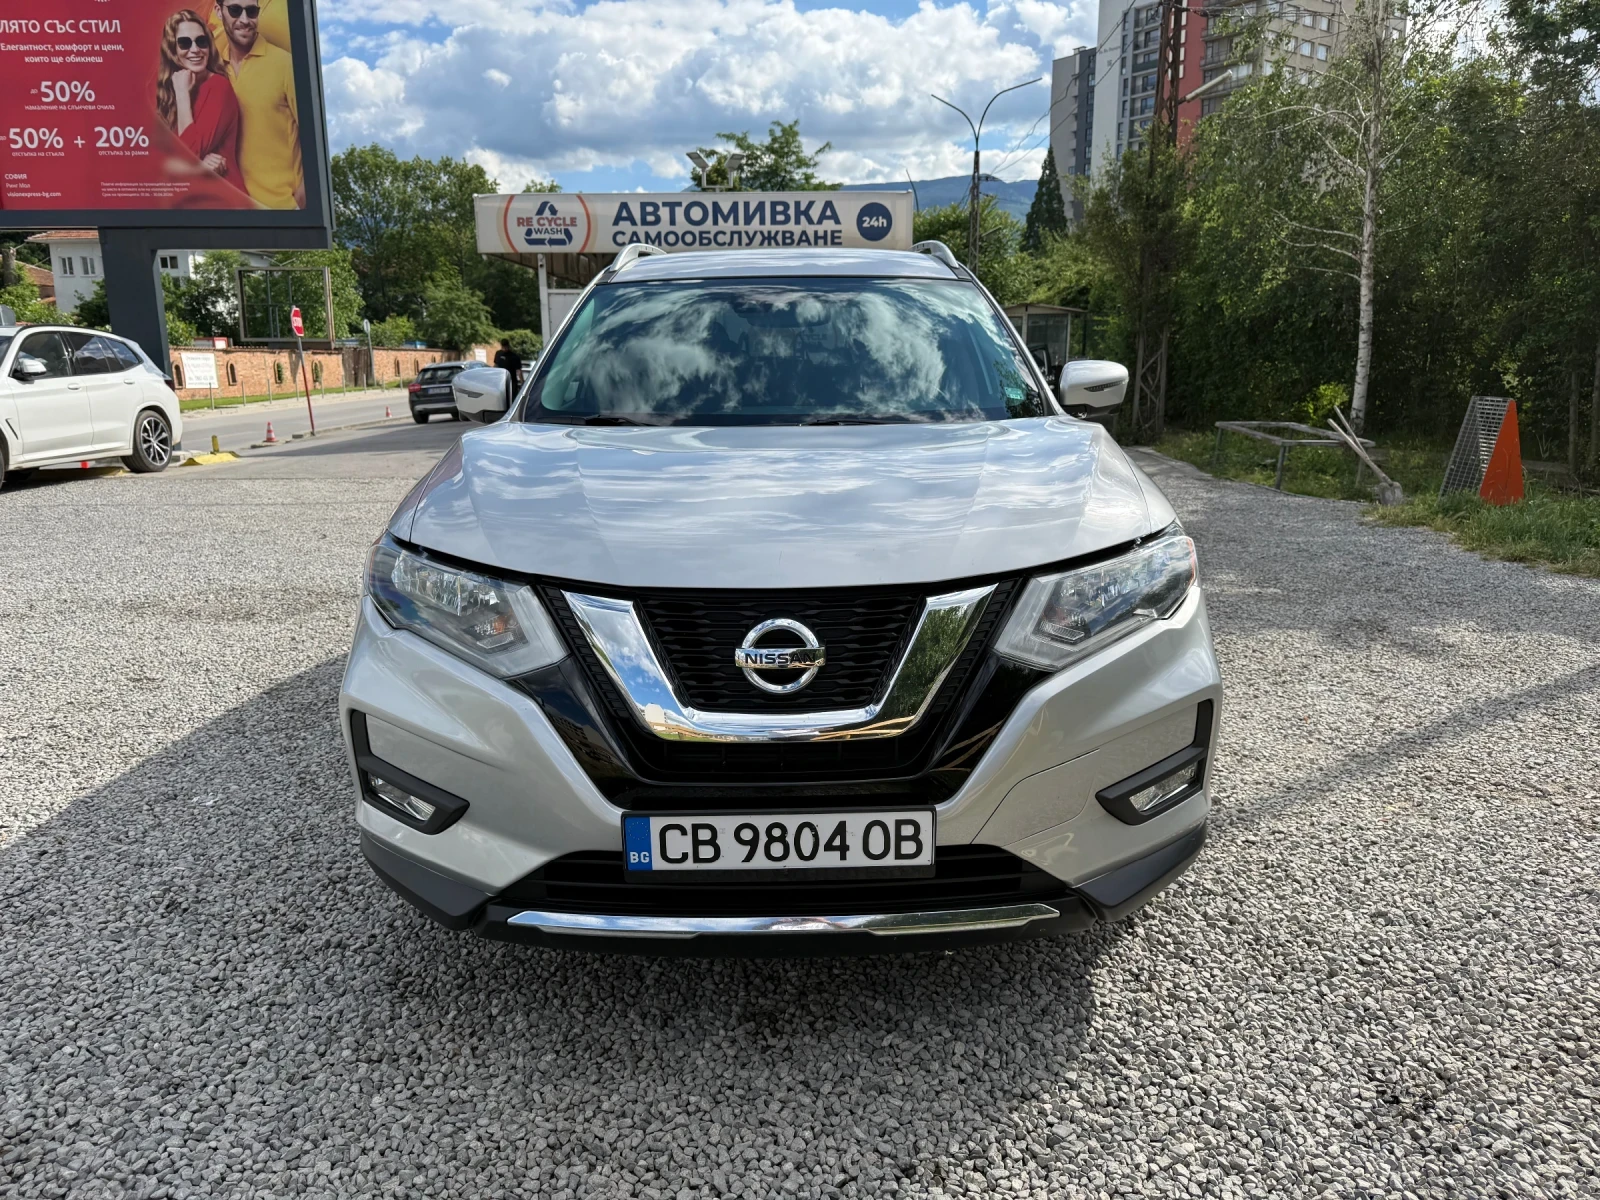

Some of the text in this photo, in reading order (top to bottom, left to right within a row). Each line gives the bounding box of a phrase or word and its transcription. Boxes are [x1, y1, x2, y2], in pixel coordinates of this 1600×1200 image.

[0, 20, 121, 33] ЛЯТО СЪС СТИЛ
[55, 43, 92, 52] комфорт
[101, 44, 124, 52] цени,
[51, 56, 64, 64] ще
[65, 54, 103, 62] обикнеш
[40, 81, 96, 102] 50%
[8, 128, 64, 149] 50%
[94, 126, 150, 147] 20%
[611, 200, 842, 227] АВТОМИВКА
[516, 217, 578, 227] RE CYCLE
[862, 216, 888, 228] 24h
[611, 229, 844, 247] САМООБСЛУЖВАНЕ
[744, 653, 816, 665] NISSAN
[733, 820, 850, 863] 9804
[629, 852, 650, 863] BG
